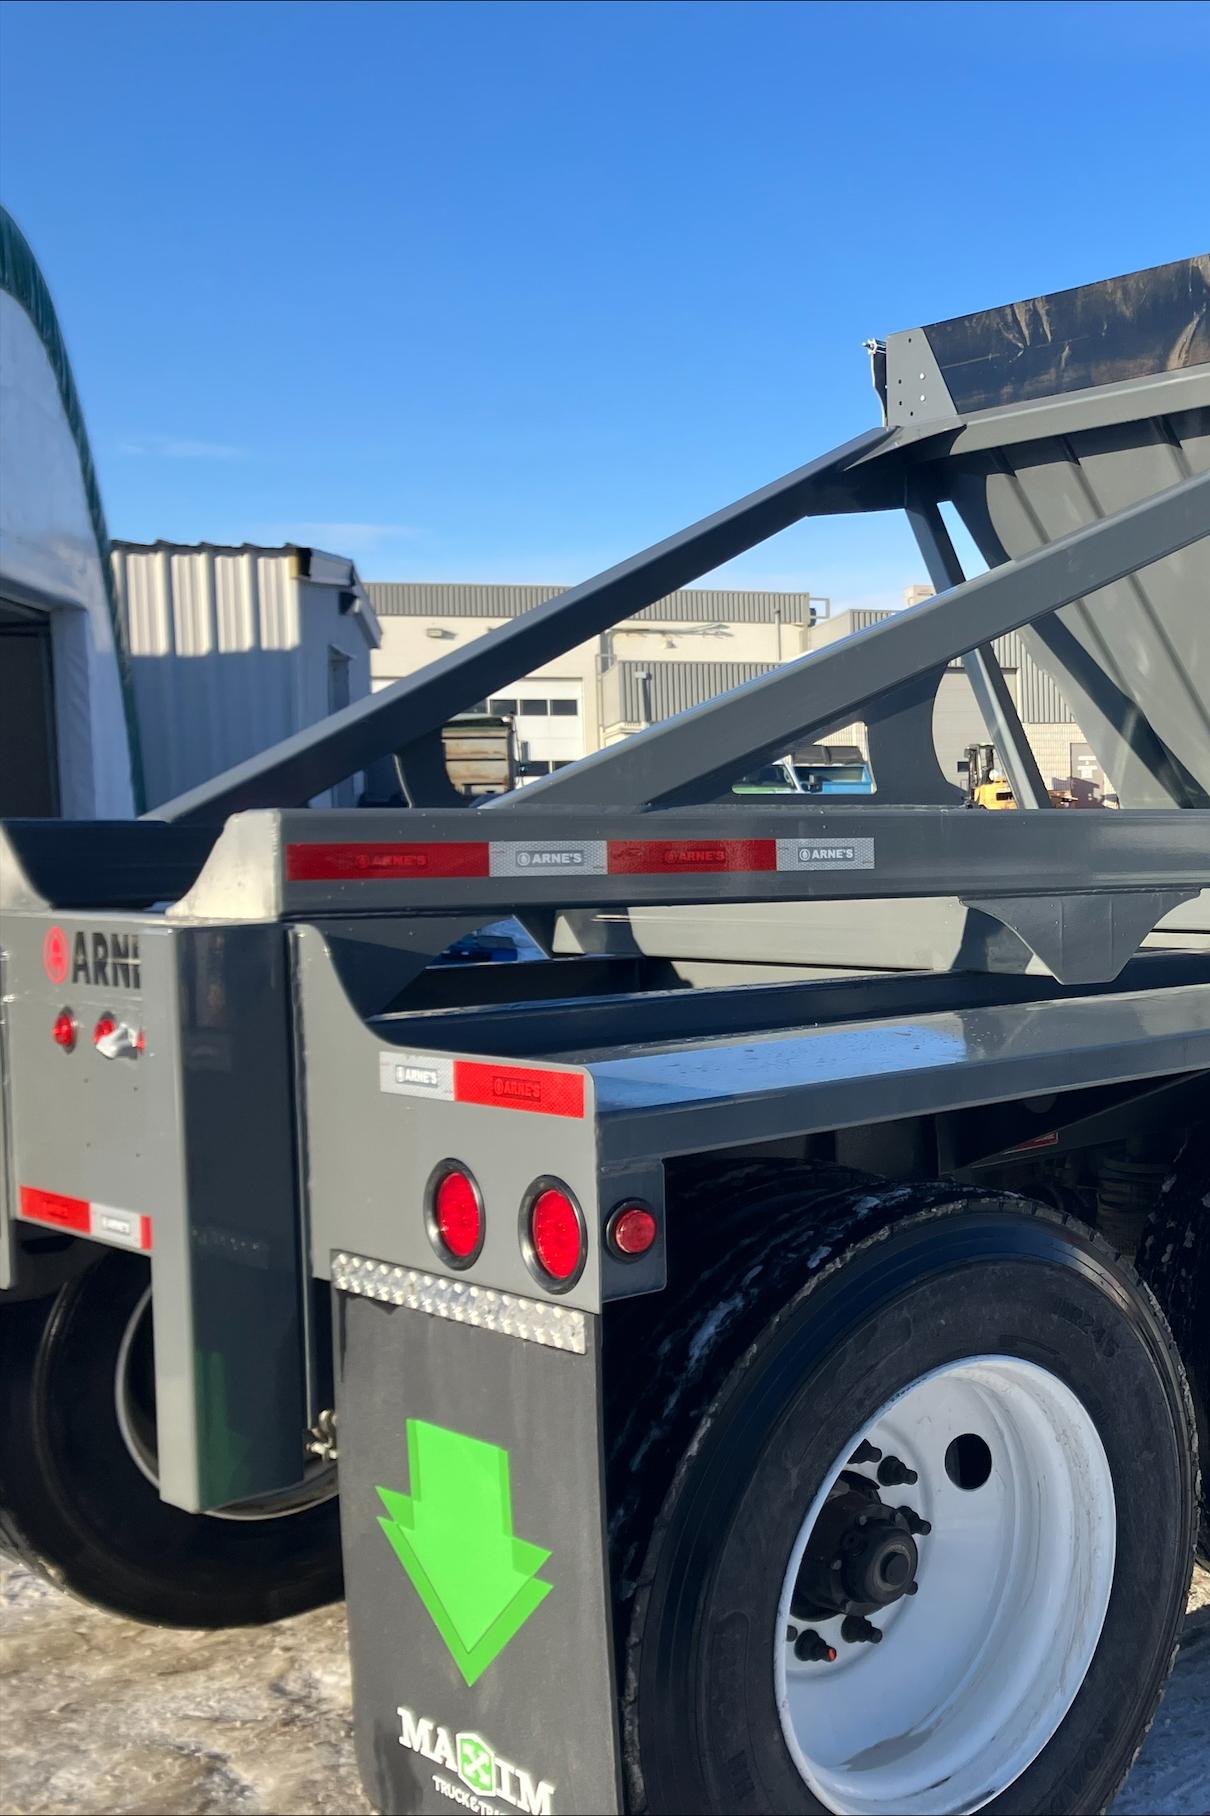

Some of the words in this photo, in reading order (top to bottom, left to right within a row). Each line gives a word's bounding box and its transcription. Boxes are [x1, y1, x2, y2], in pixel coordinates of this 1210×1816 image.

[531, 852, 583, 865] ARNE'S
[811, 847, 855, 860] ARNE'S
[397, 1706, 556, 1815] MAXIM
[432, 1774, 471, 1809] TRUCK
